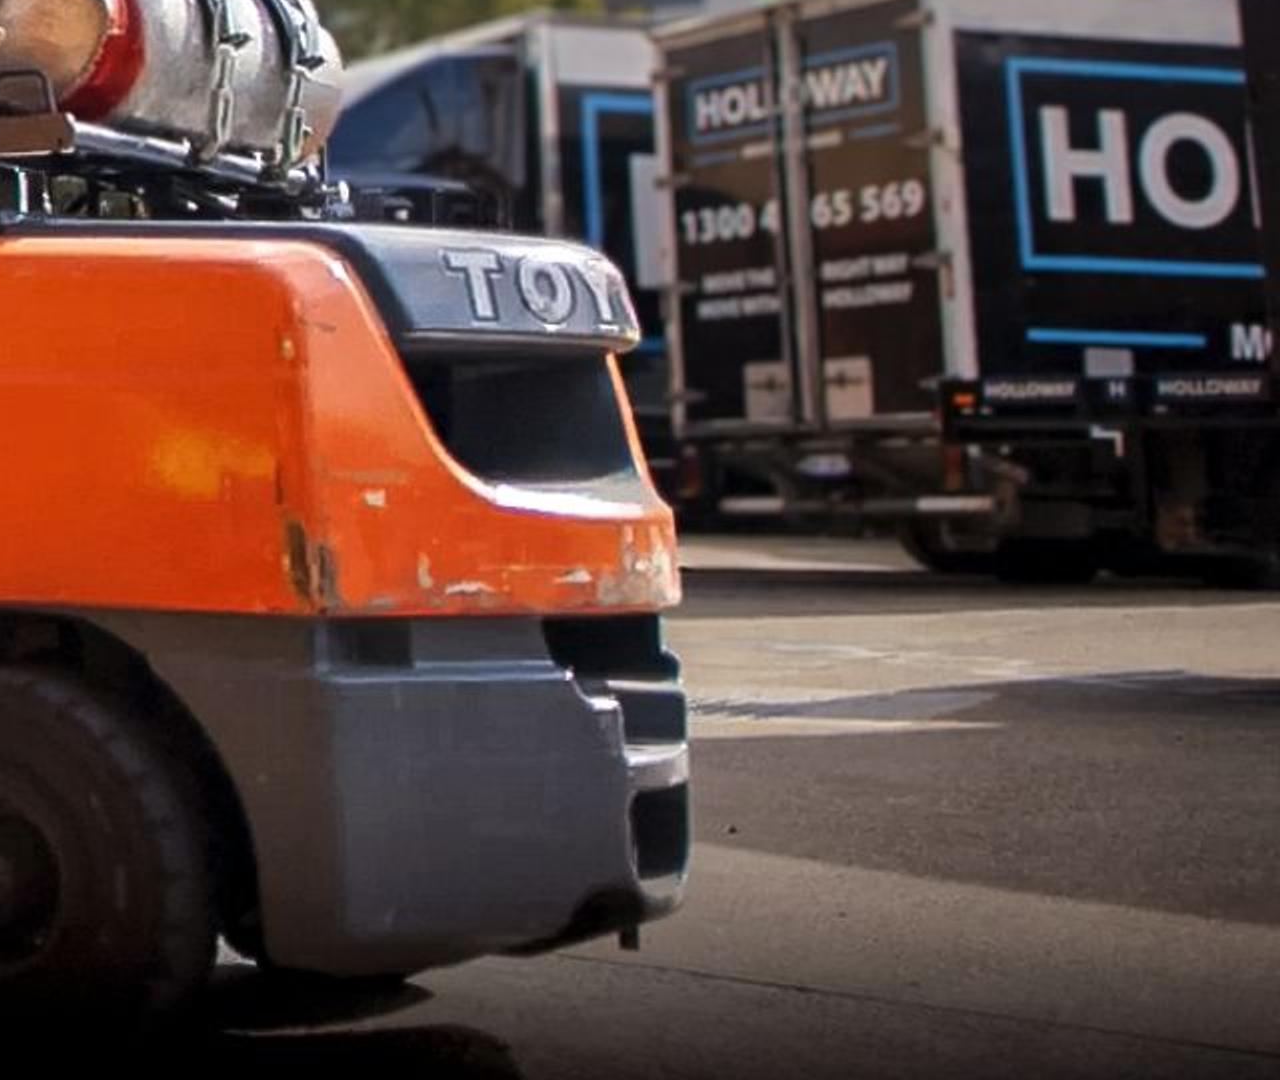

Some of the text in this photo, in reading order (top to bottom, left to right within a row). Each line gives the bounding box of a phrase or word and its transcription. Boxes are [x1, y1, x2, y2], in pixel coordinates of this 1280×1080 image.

[694, 57, 888, 131] HOLWAY
[1038, 104, 1262, 230] HO
[682, 203, 755, 245] 1300
[860, 177, 925, 225] 569
[1231, 322, 1272, 361] M
[984, 381, 1076, 399] HOLLOWAY
[1158, 378, 1261, 395] HOLLOWAY
